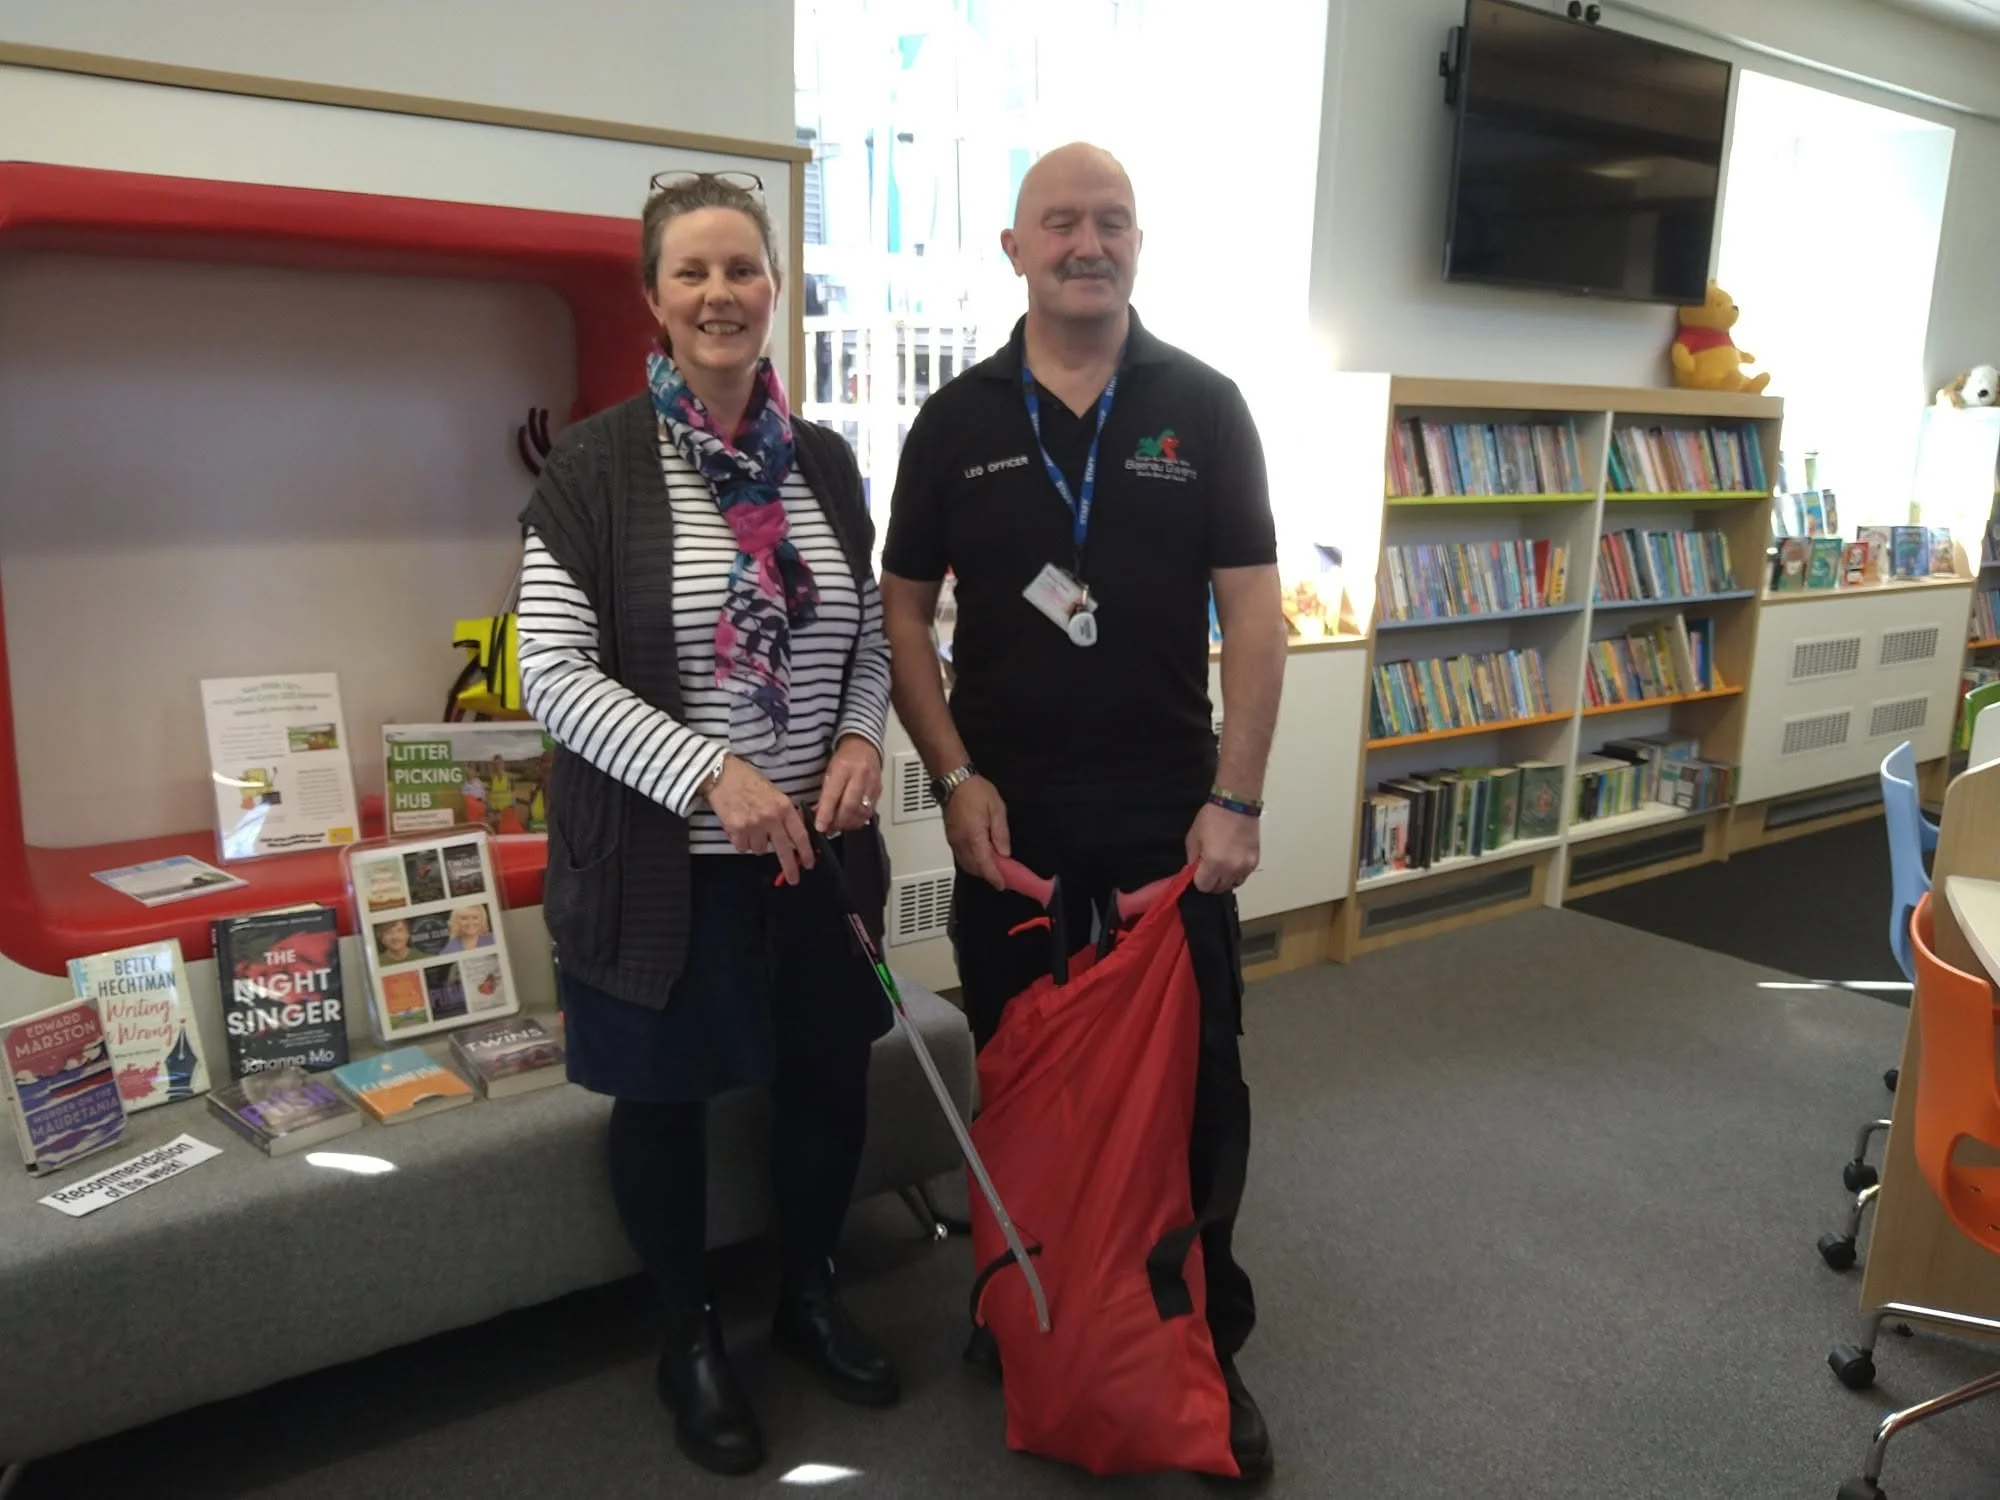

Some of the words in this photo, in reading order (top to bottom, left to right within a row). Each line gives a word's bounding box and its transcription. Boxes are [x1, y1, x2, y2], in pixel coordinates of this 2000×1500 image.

[987, 455, 1029, 473] OFFICER
[393, 744, 450, 761] LITTER
[394, 768, 463, 785] PICKING
[395, 792, 432, 808] HUB
[114, 955, 157, 976] BETTY
[264, 949, 297, 966] THE
[98, 971, 177, 997] HECHTMAN
[232, 967, 332, 1003] NIGHT
[107, 998, 171, 1023] Writing
[227, 998, 341, 1036] SINGER
[25, 1012, 82, 1038] EDWARD
[118, 1022, 176, 1047] Wrong
[15, 1020, 97, 1058] MARSTON
[309, 1048, 335, 1065] Mo
[52, 1142, 193, 1203] Recommendation
[104, 1185, 121, 1198] of
[119, 1174, 150, 1190] the
